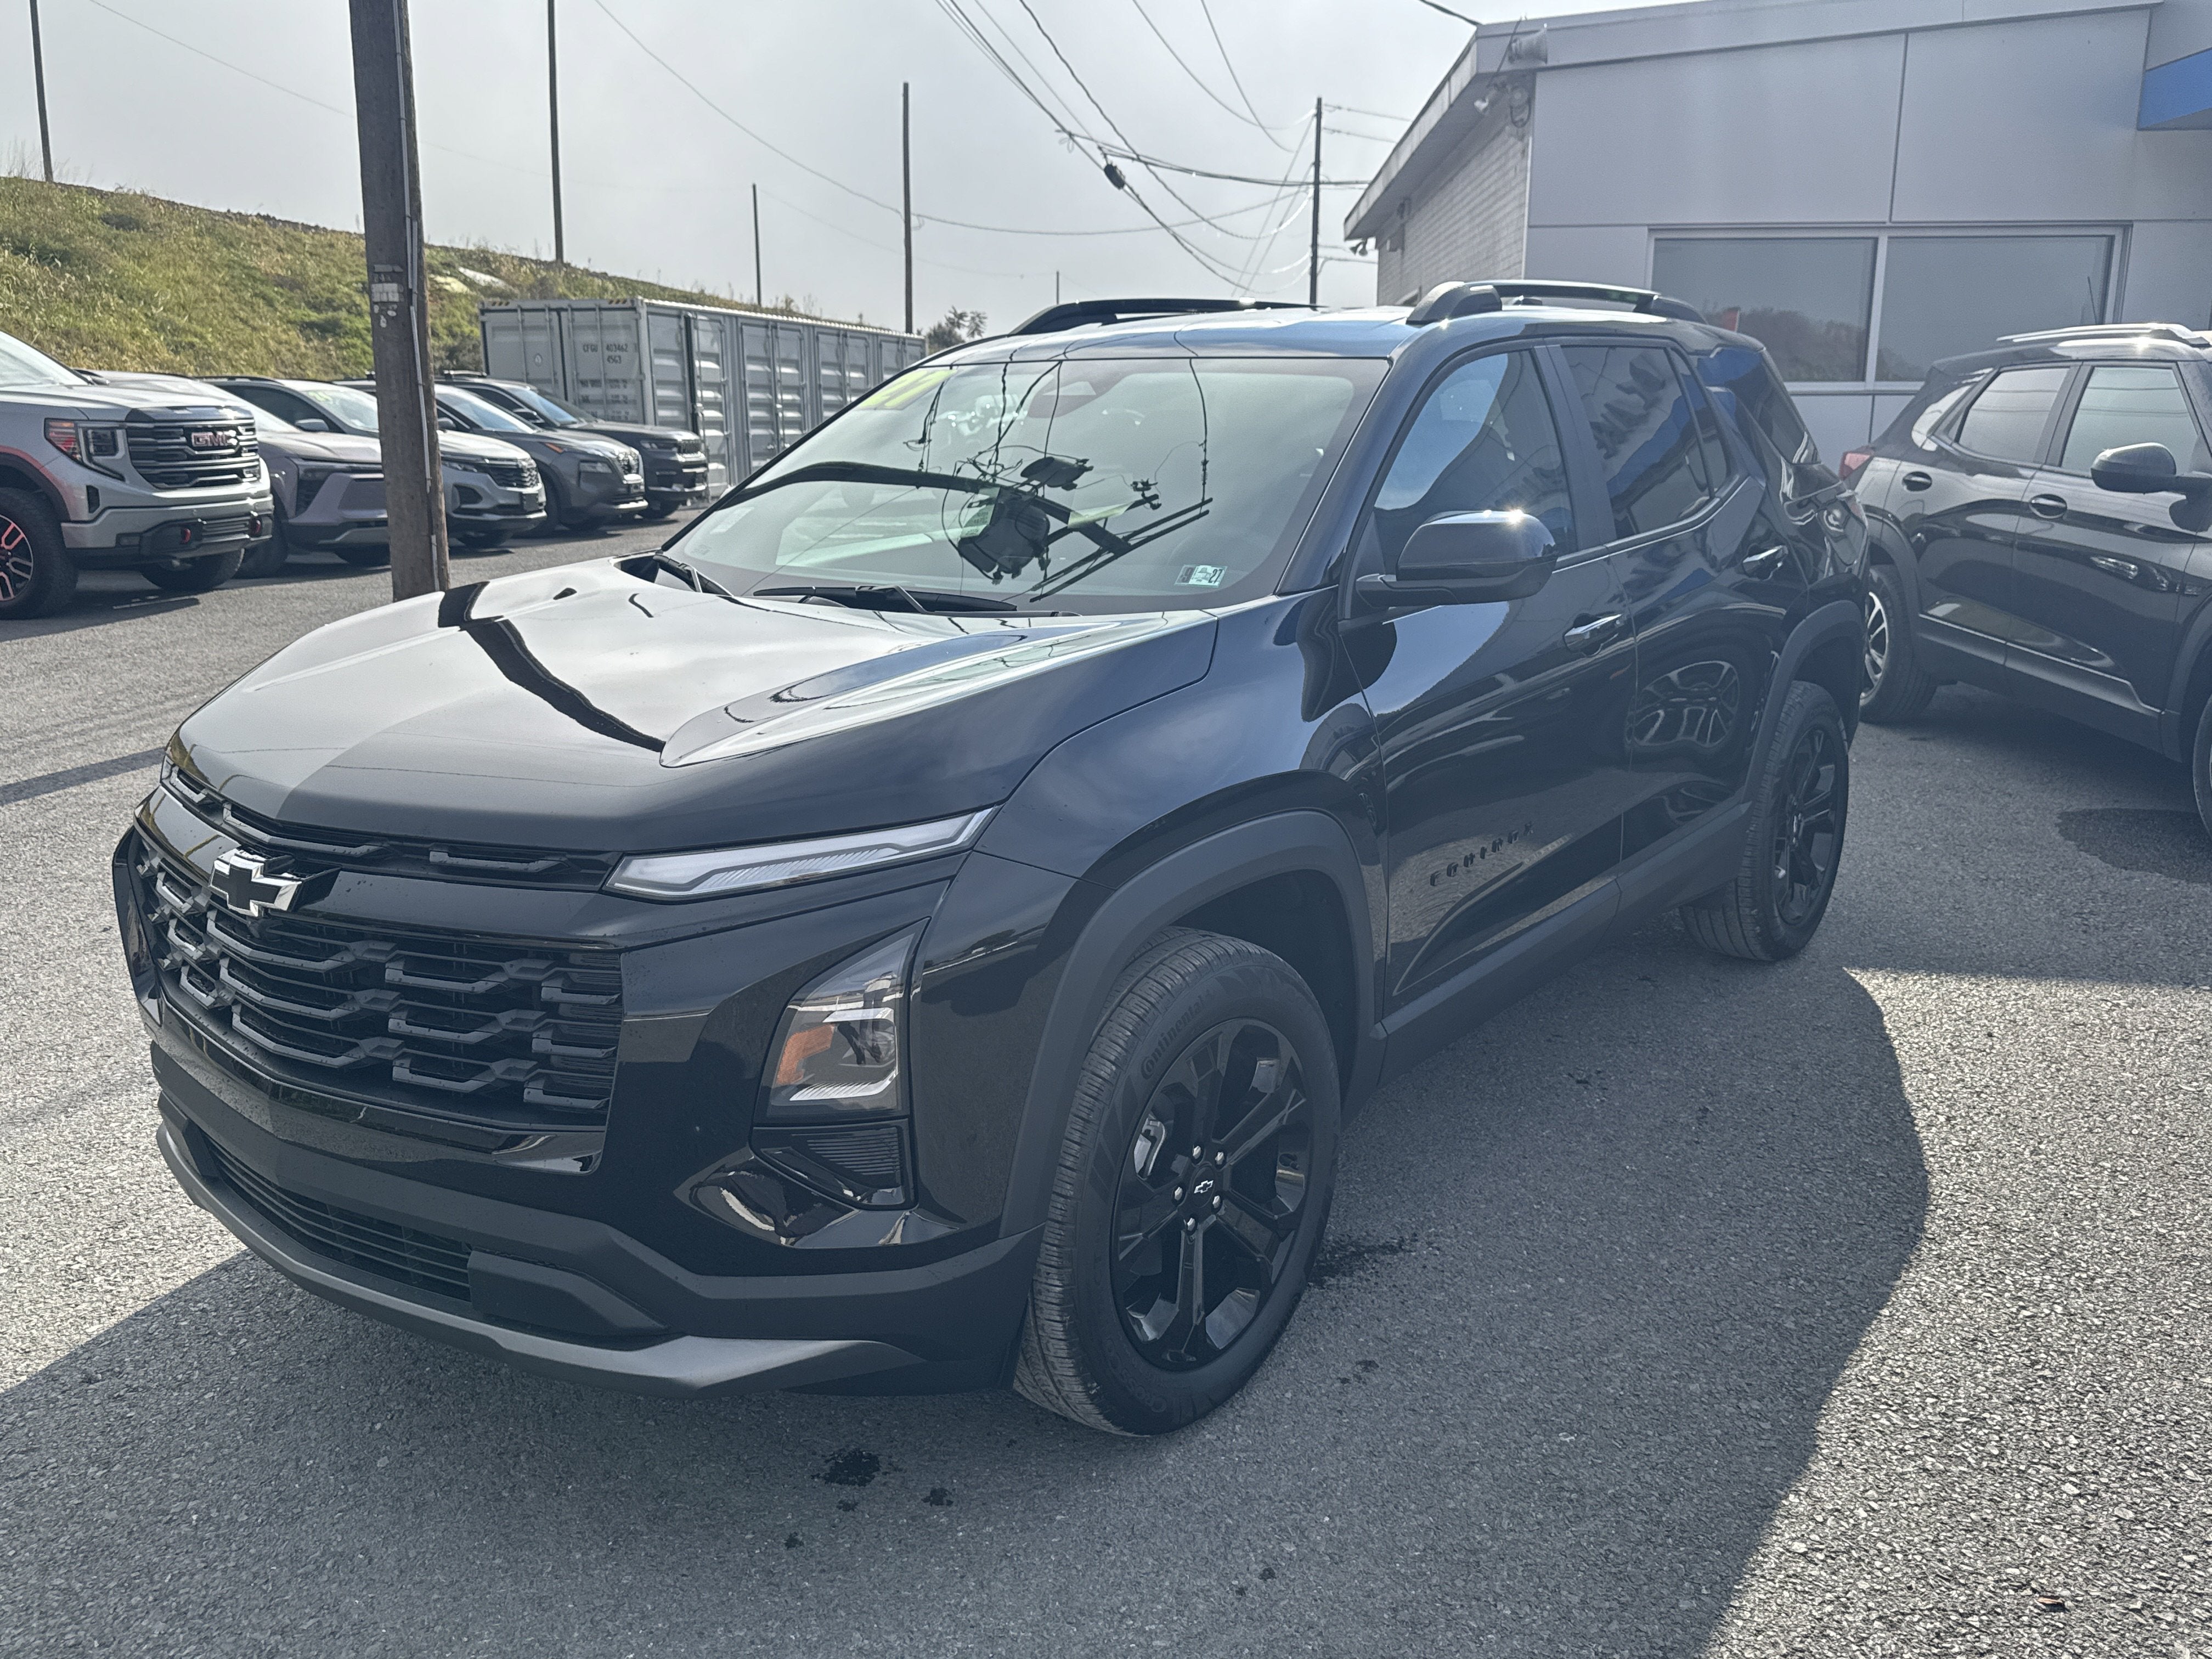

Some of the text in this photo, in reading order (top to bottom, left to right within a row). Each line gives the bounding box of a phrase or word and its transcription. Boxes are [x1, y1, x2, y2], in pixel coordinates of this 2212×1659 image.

[191, 431, 238, 447] GMC
[1208, 568, 1223, 584] 27
[1141, 995, 1206, 1080] Continental
